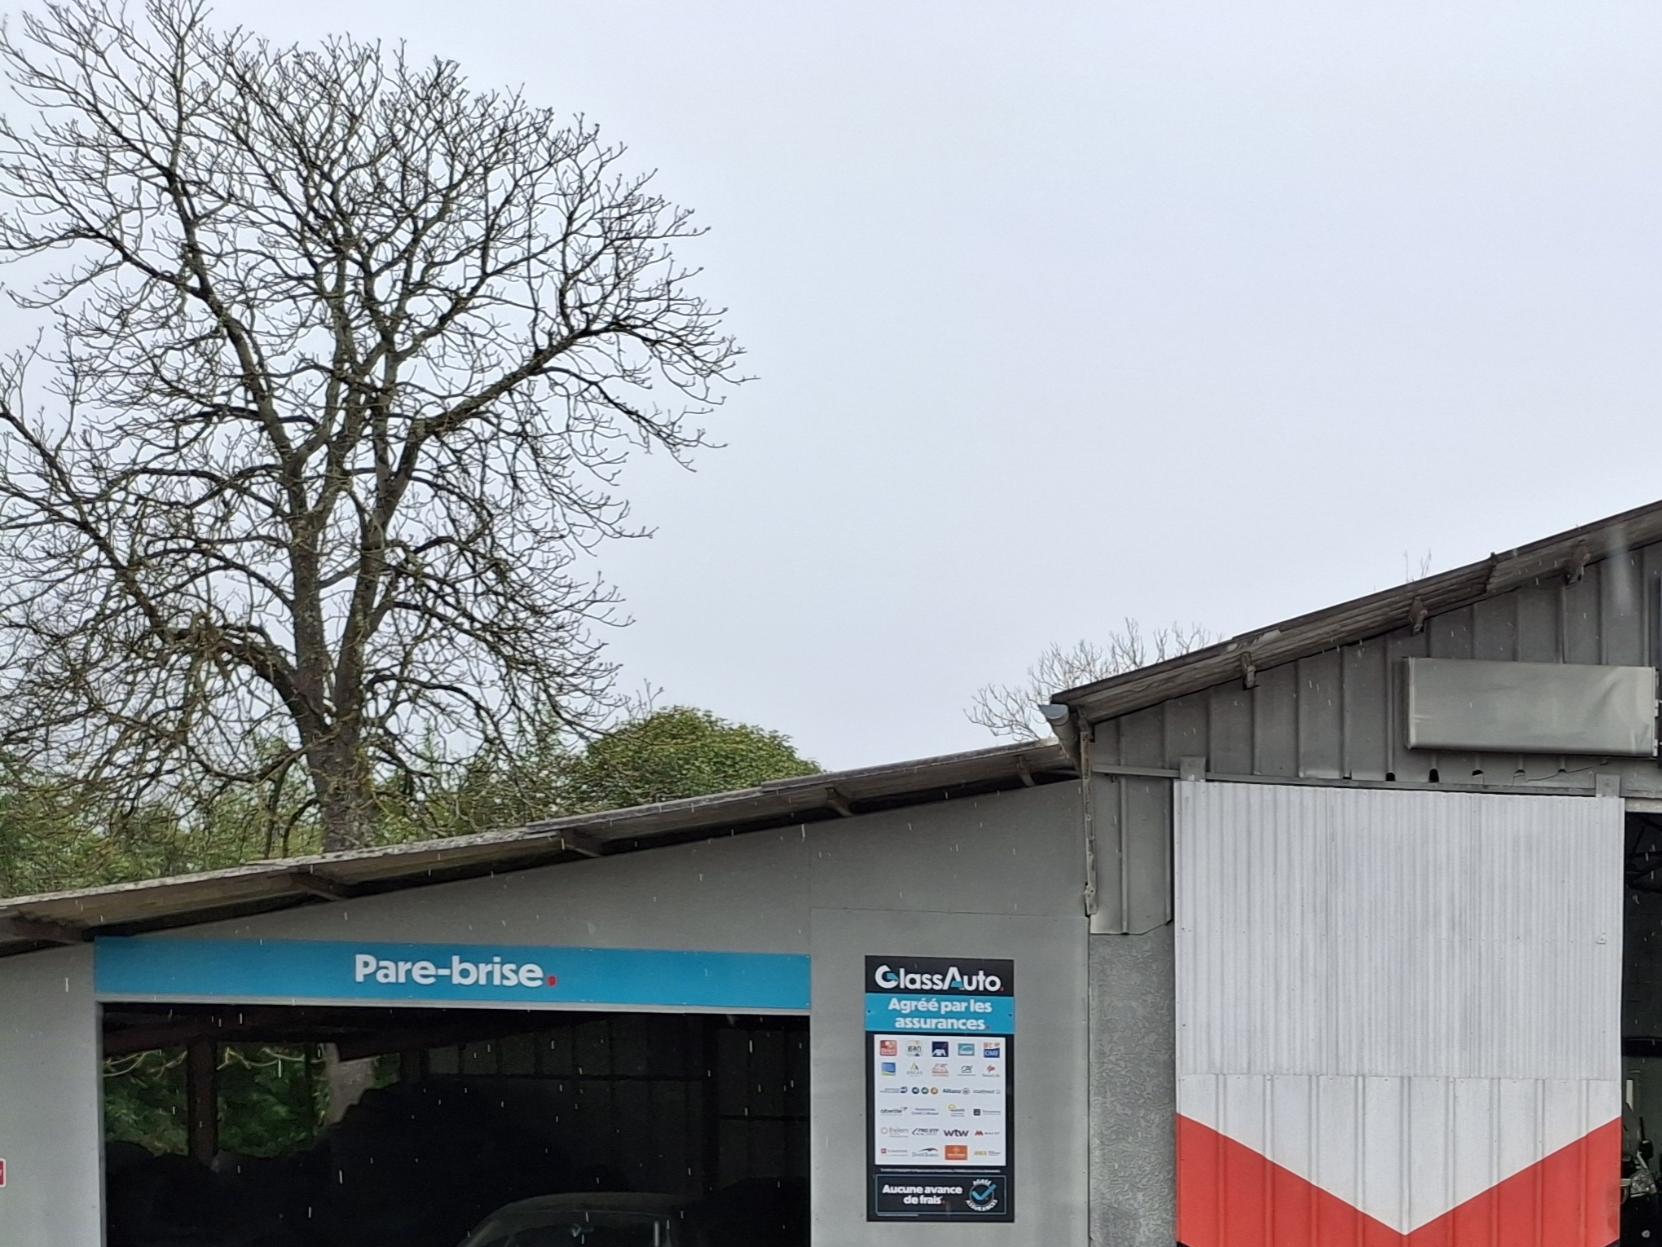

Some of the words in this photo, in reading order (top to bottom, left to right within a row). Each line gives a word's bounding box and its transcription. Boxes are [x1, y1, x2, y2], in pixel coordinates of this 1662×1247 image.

[355, 954, 557, 987] Pare-brise.
[888, 998, 937, 1013] Agréé
[940, 1001, 967, 1014] par
[970, 999, 992, 1012] les
[943, 1129, 969, 1137] wtw
[882, 1184, 923, 1194] Aucune
[924, 1185, 963, 1194] avance
[903, 1195, 919, 1204] de
